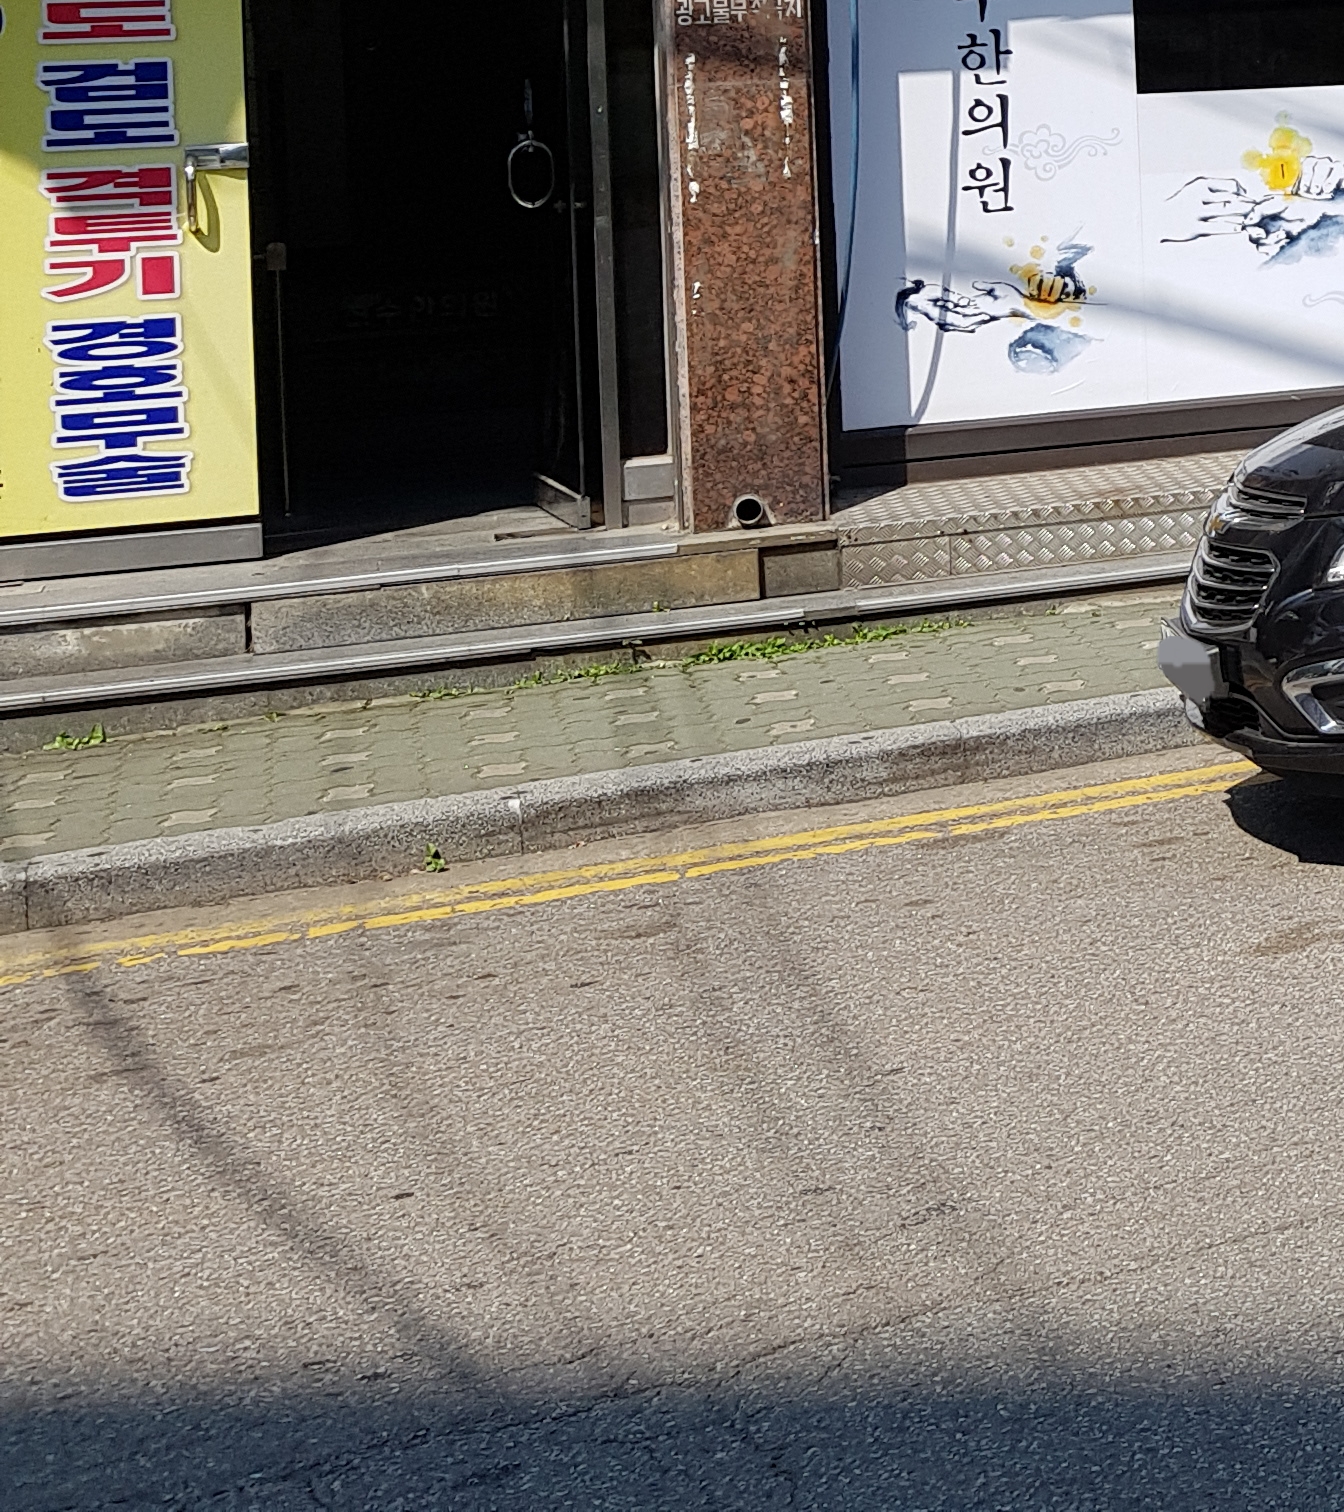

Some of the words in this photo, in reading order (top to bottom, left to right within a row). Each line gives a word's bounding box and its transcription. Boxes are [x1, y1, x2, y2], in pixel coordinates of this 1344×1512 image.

[36, 56, 180, 153] 검도
[38, 162, 183, 304] 격투기
[43, 313, 195, 503] 경호무술
